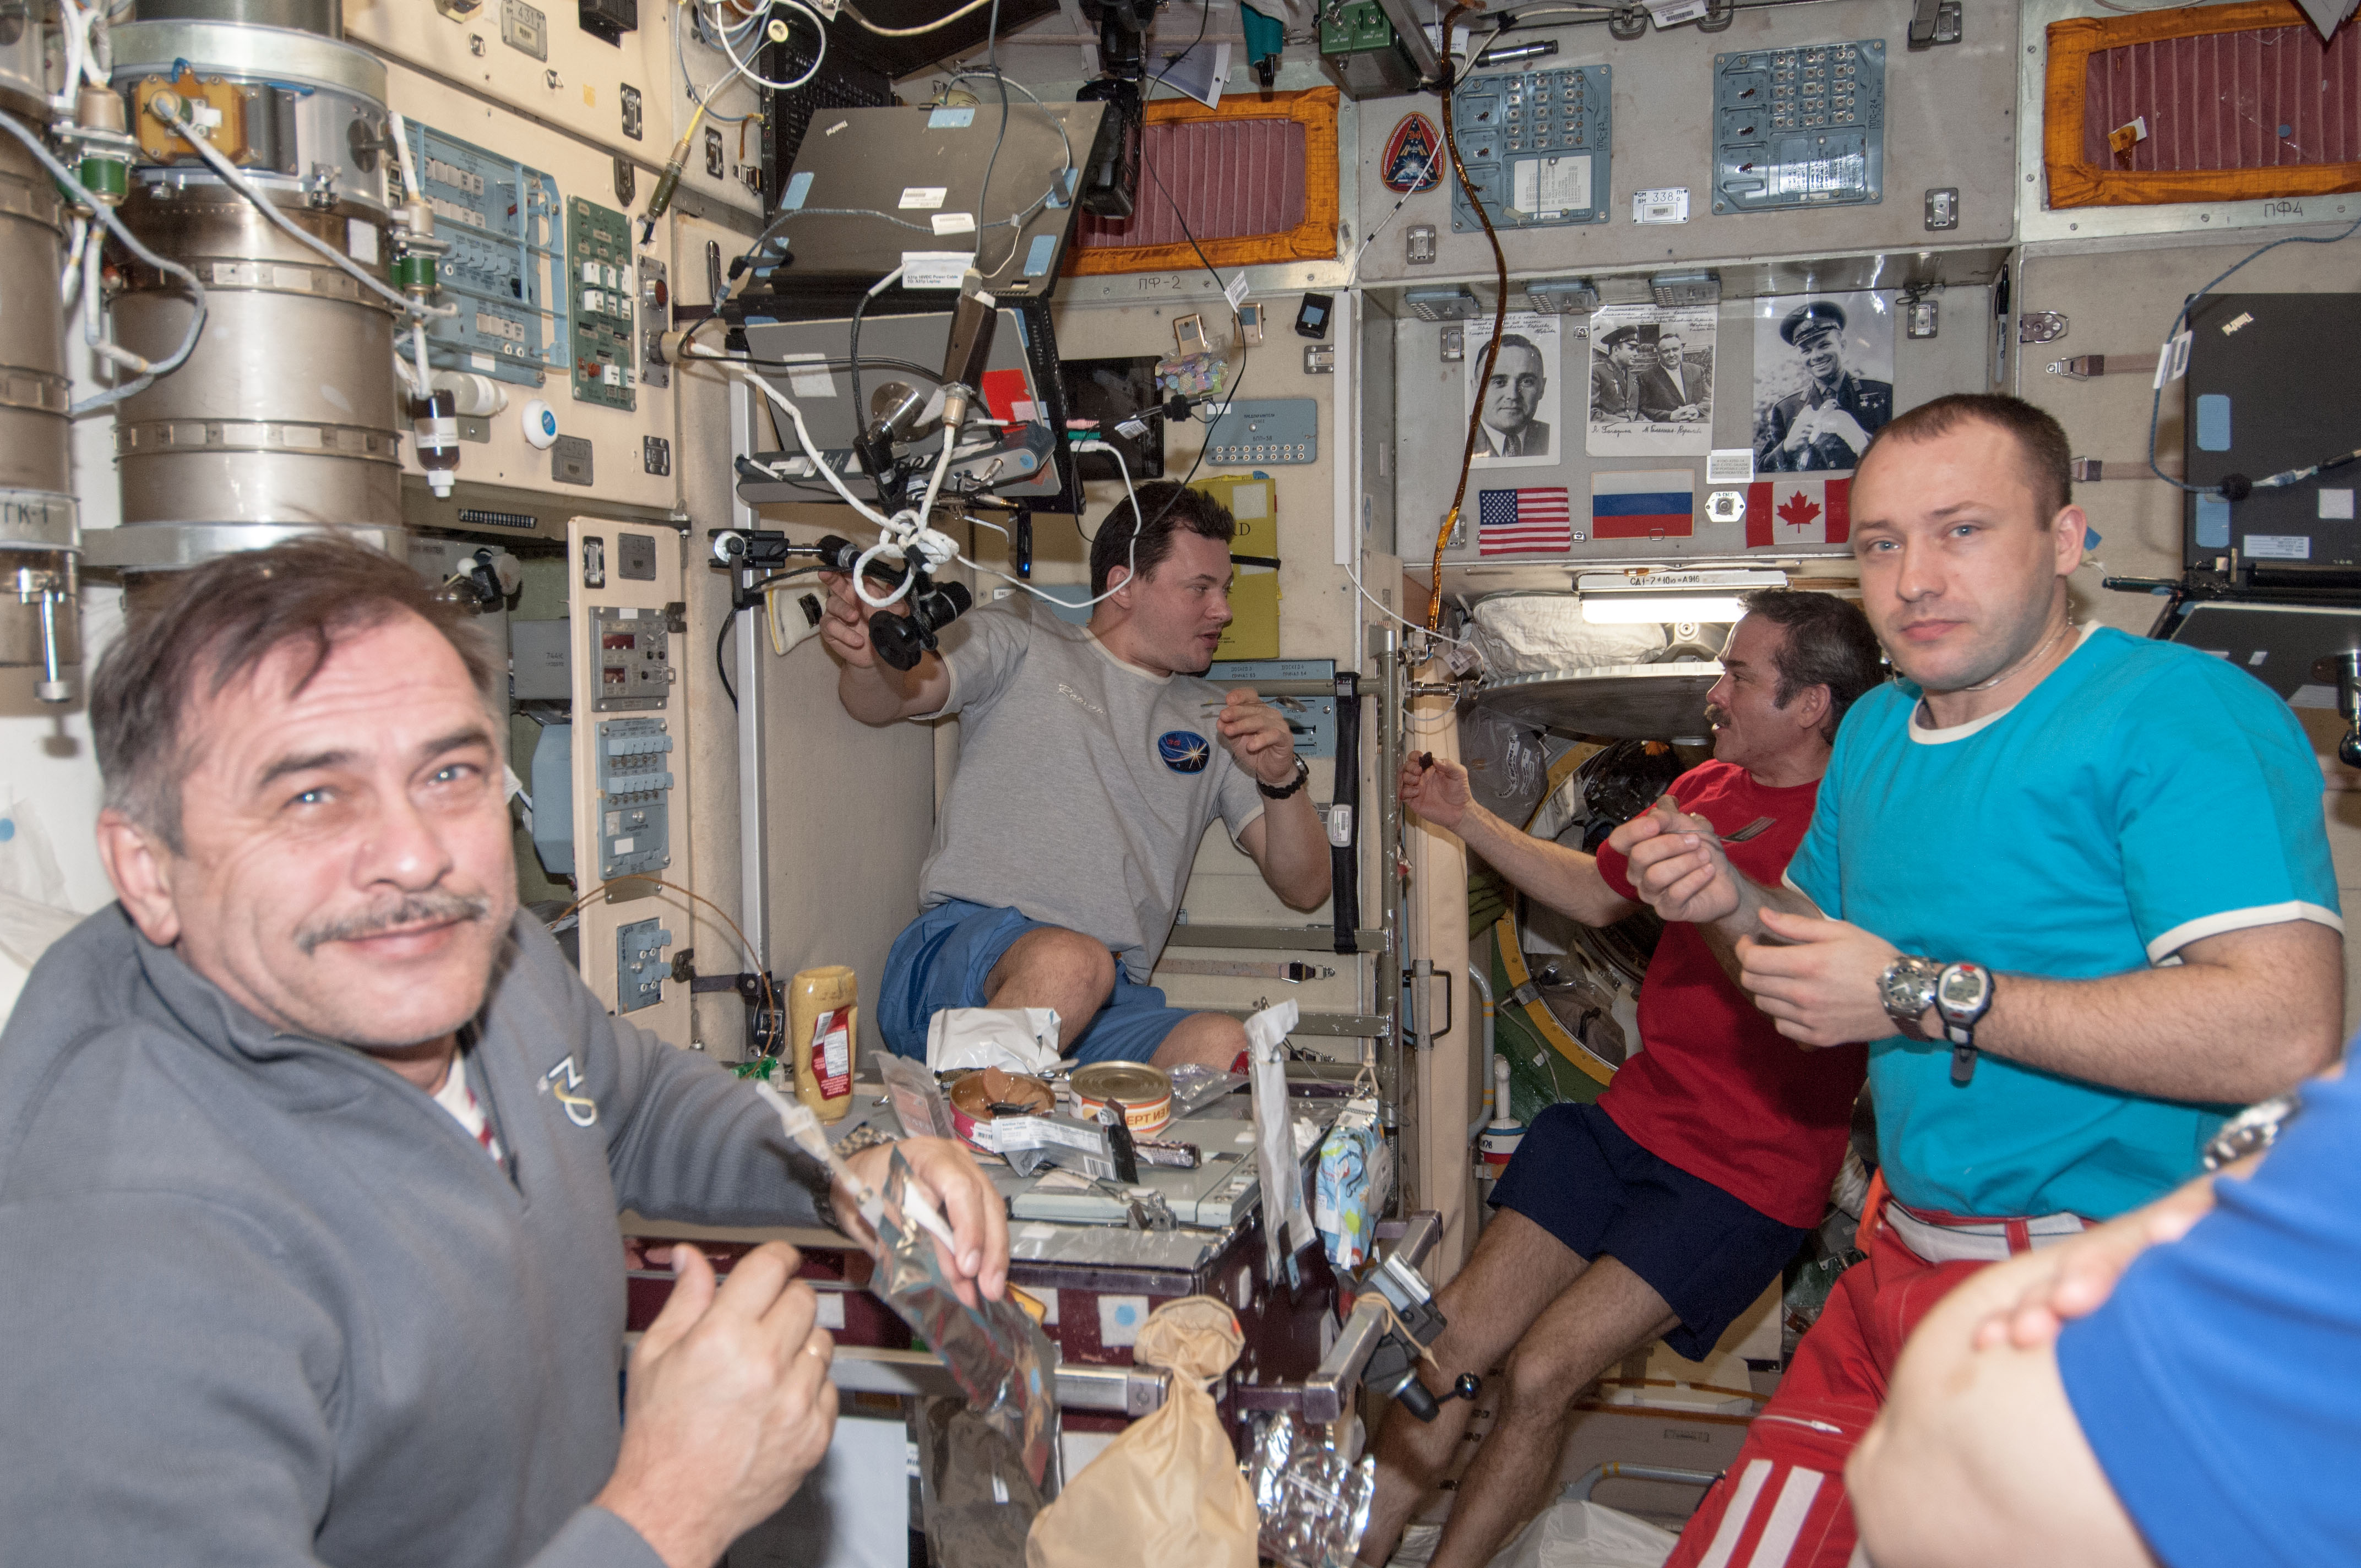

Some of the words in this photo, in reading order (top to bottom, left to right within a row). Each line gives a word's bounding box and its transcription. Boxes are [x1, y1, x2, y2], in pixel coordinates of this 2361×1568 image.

[1869, 99, 1878, 130] ППС-24
[826, 119, 848, 137] ThinkPad
[1407, 130, 1422, 140] 34
[1596, 122, 1604, 151] ППС-23
[1653, 192, 1673, 202] 338
[2264, 200, 2304, 218] ПФ4
[1139, 276, 1181, 291] ПФ-2
[1126, 1113, 1151, 1125] ЕРТ
[1153, 1108, 1165, 1121] ИЗ
